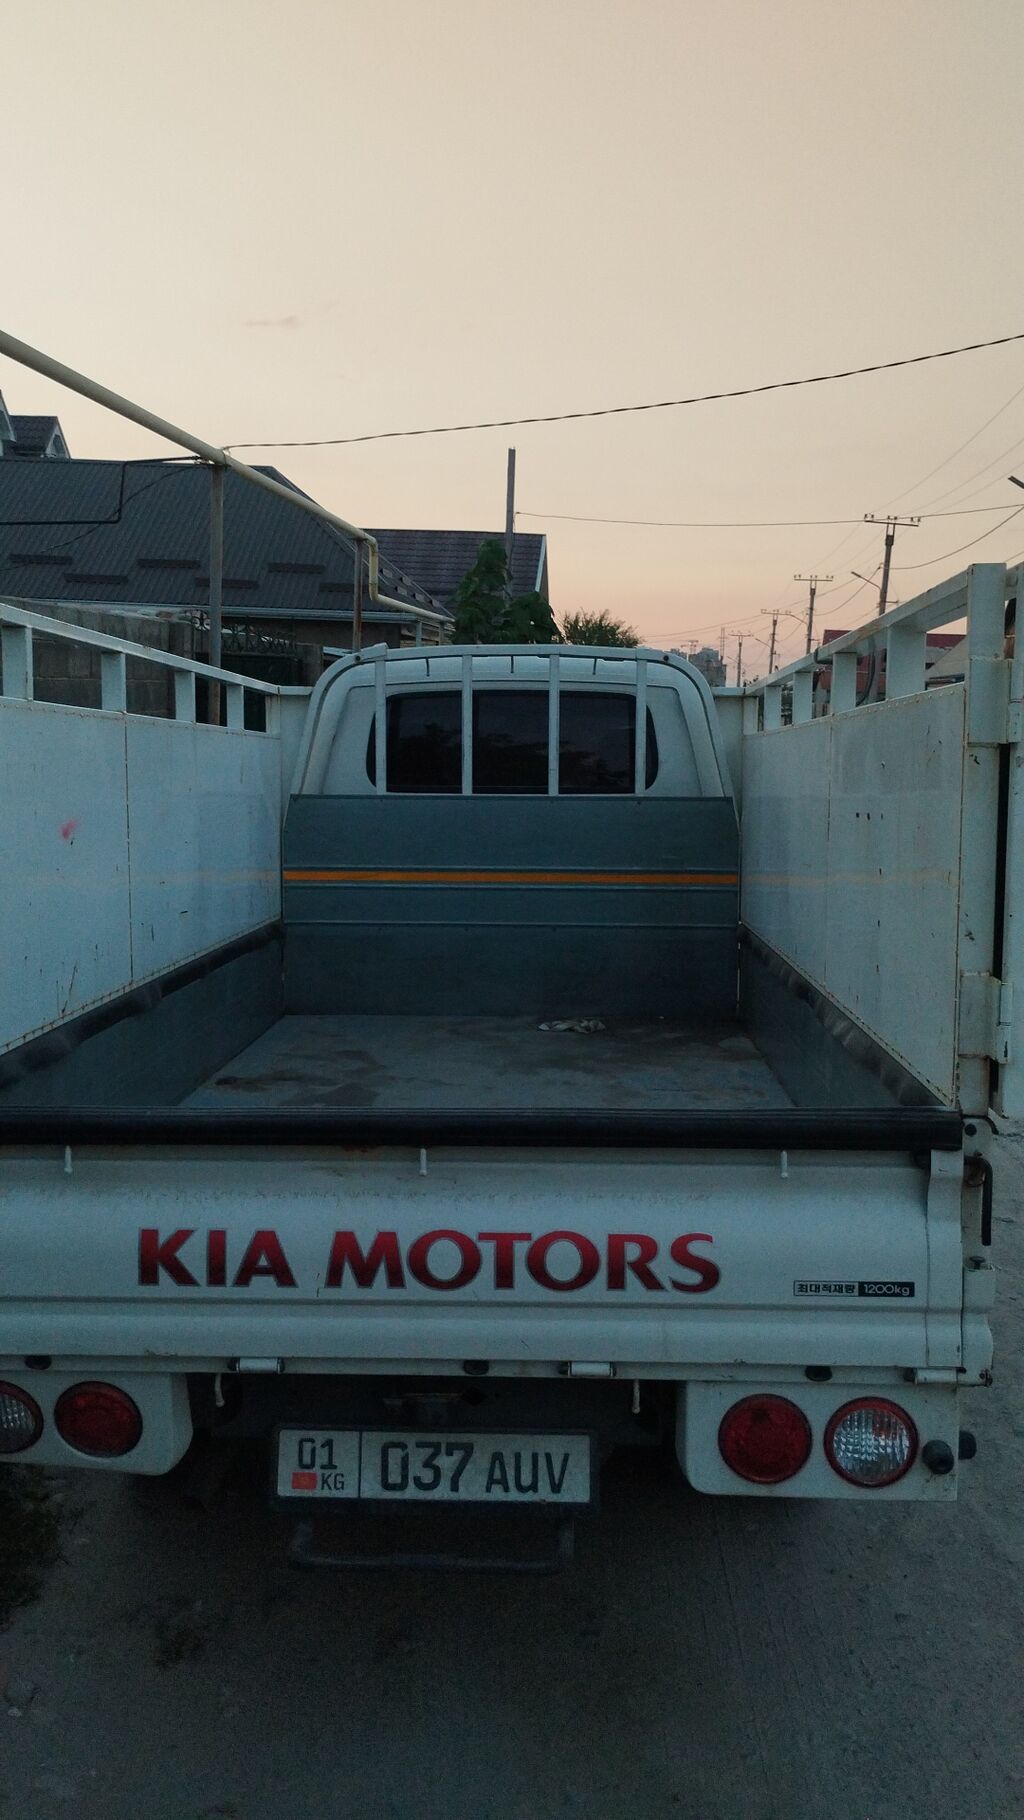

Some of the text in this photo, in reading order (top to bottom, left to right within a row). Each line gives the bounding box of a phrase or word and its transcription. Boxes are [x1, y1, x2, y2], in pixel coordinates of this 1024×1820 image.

[138, 1228, 722, 1294] KIA MOTORS
[863, 1283, 911, 1297] 1200kg
[298, 1438, 570, 1494] 01 037 AUV
[320, 1472, 346, 1491] KG
